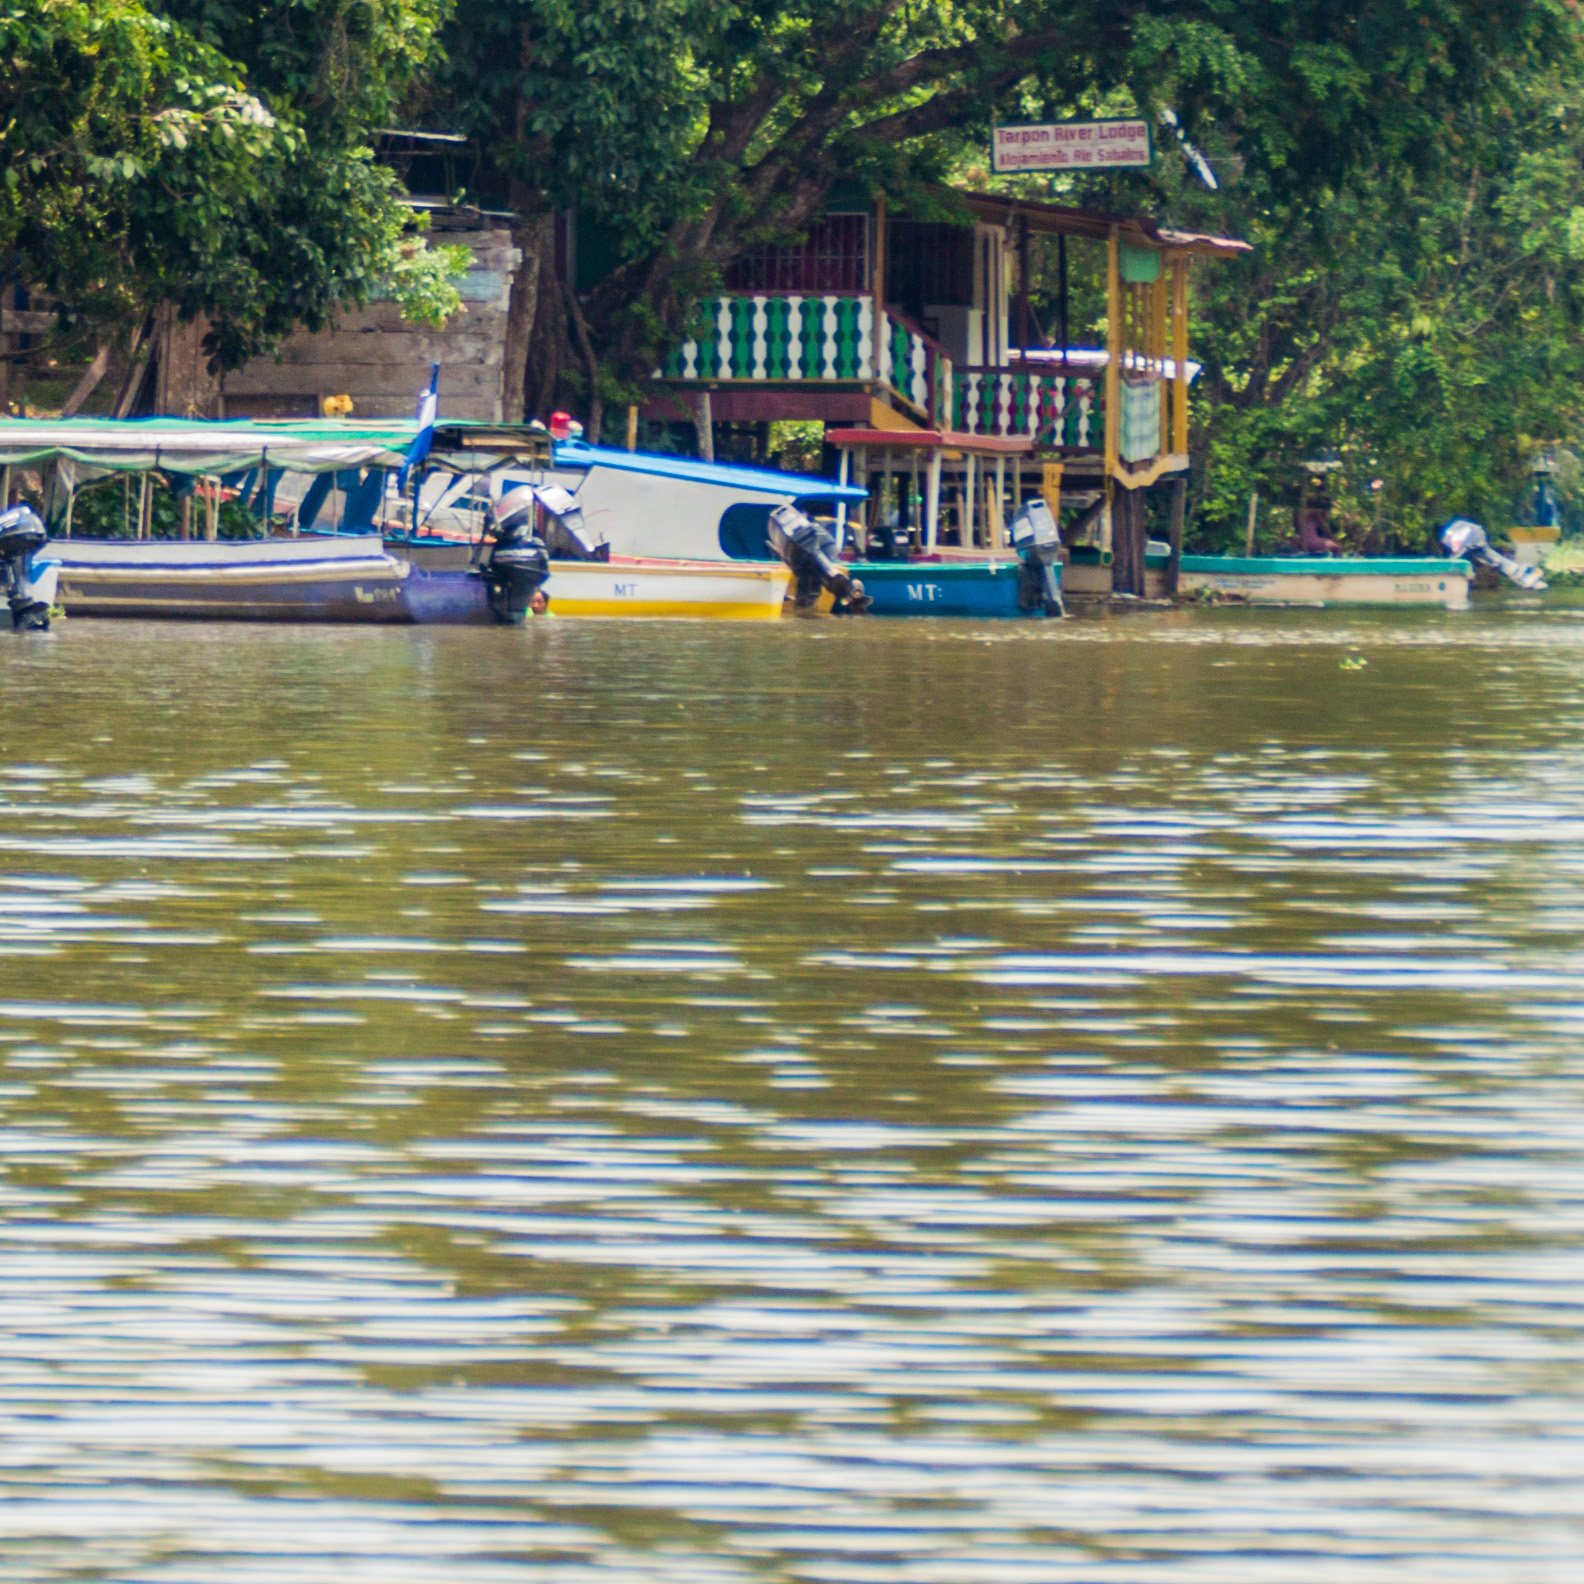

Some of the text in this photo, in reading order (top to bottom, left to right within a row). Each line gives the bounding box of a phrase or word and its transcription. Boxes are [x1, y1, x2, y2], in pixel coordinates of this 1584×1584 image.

[998, 124, 1146, 146] Tarpon River Lodge
